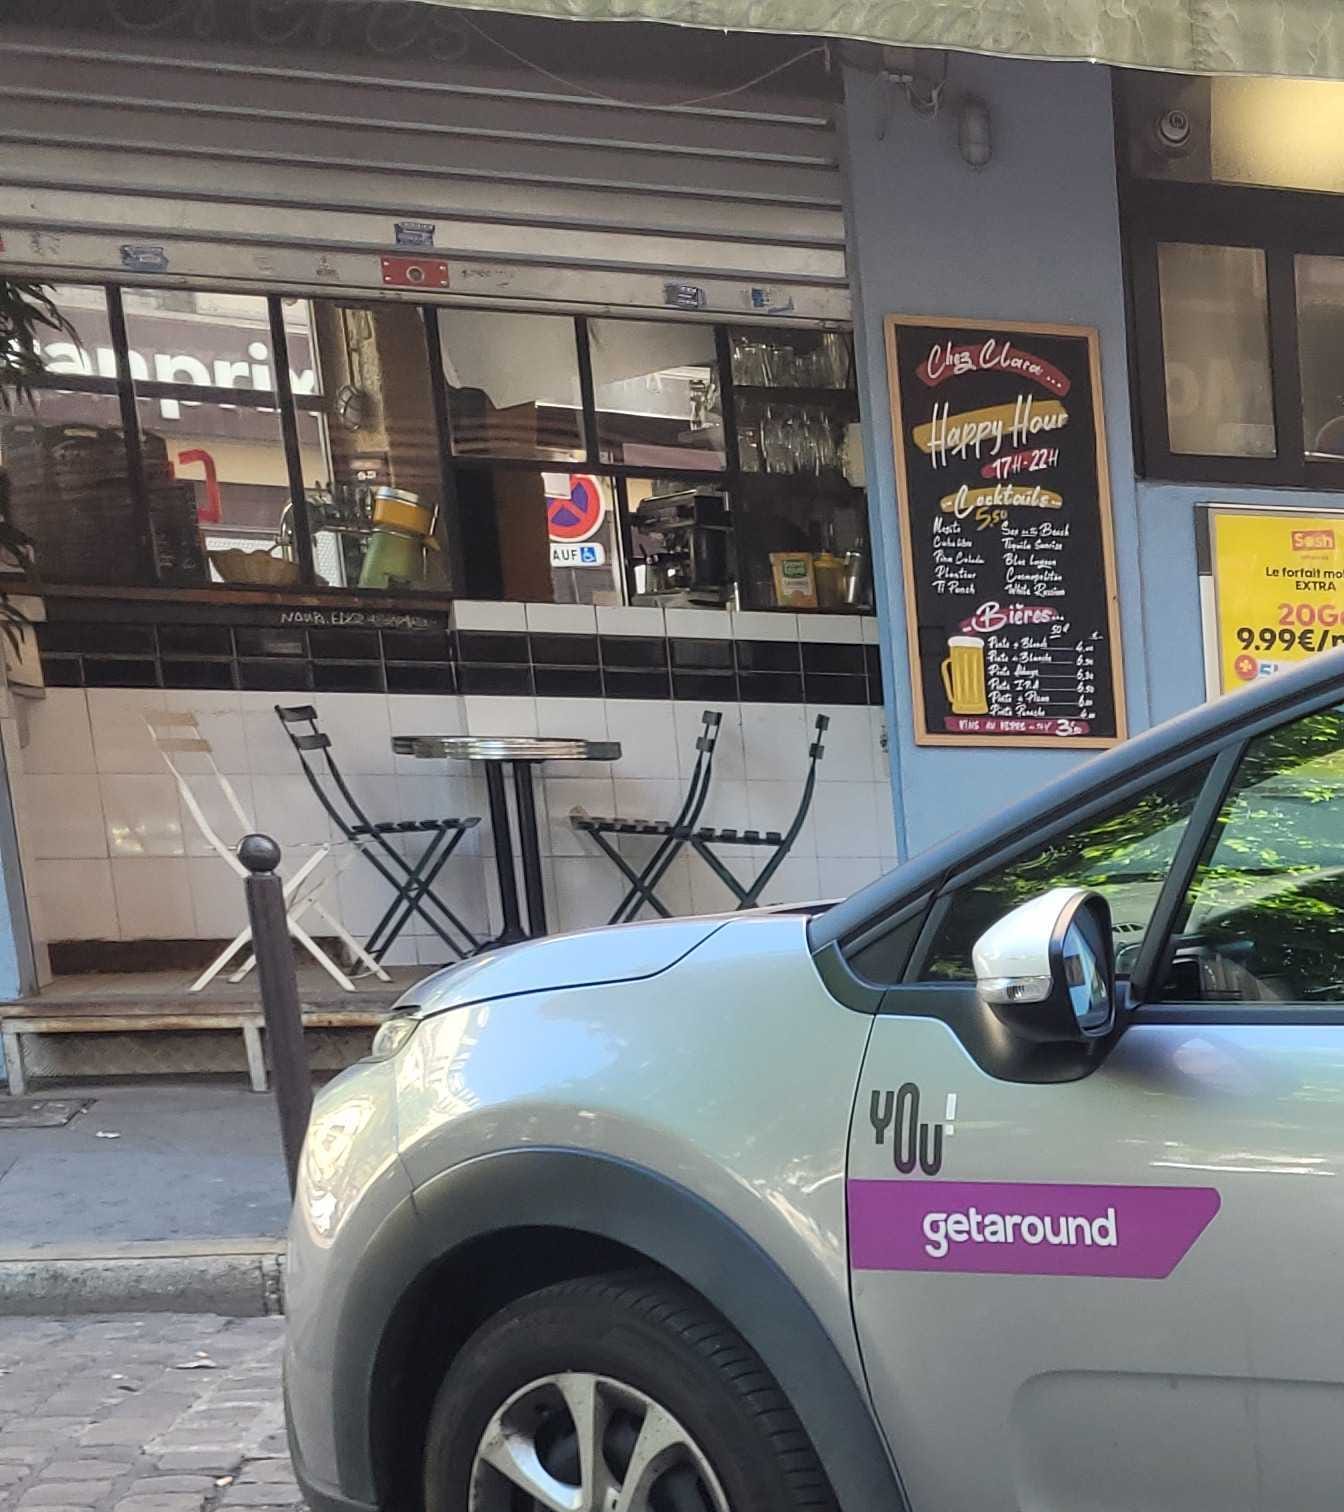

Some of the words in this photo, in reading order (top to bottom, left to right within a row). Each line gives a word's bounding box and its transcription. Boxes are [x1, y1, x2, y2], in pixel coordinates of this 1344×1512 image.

[927, 341, 976, 379] Chez
[928, 401, 1003, 470] Happy
[1009, 393, 1070, 448] Hour
[551, 549, 578, 561] AUF
[1265, 566, 1279, 577] Le
[1281, 567, 1321, 578] forfait
[1295, 580, 1337, 591] EXTRA
[922, 1207, 1118, 1258] getaround
